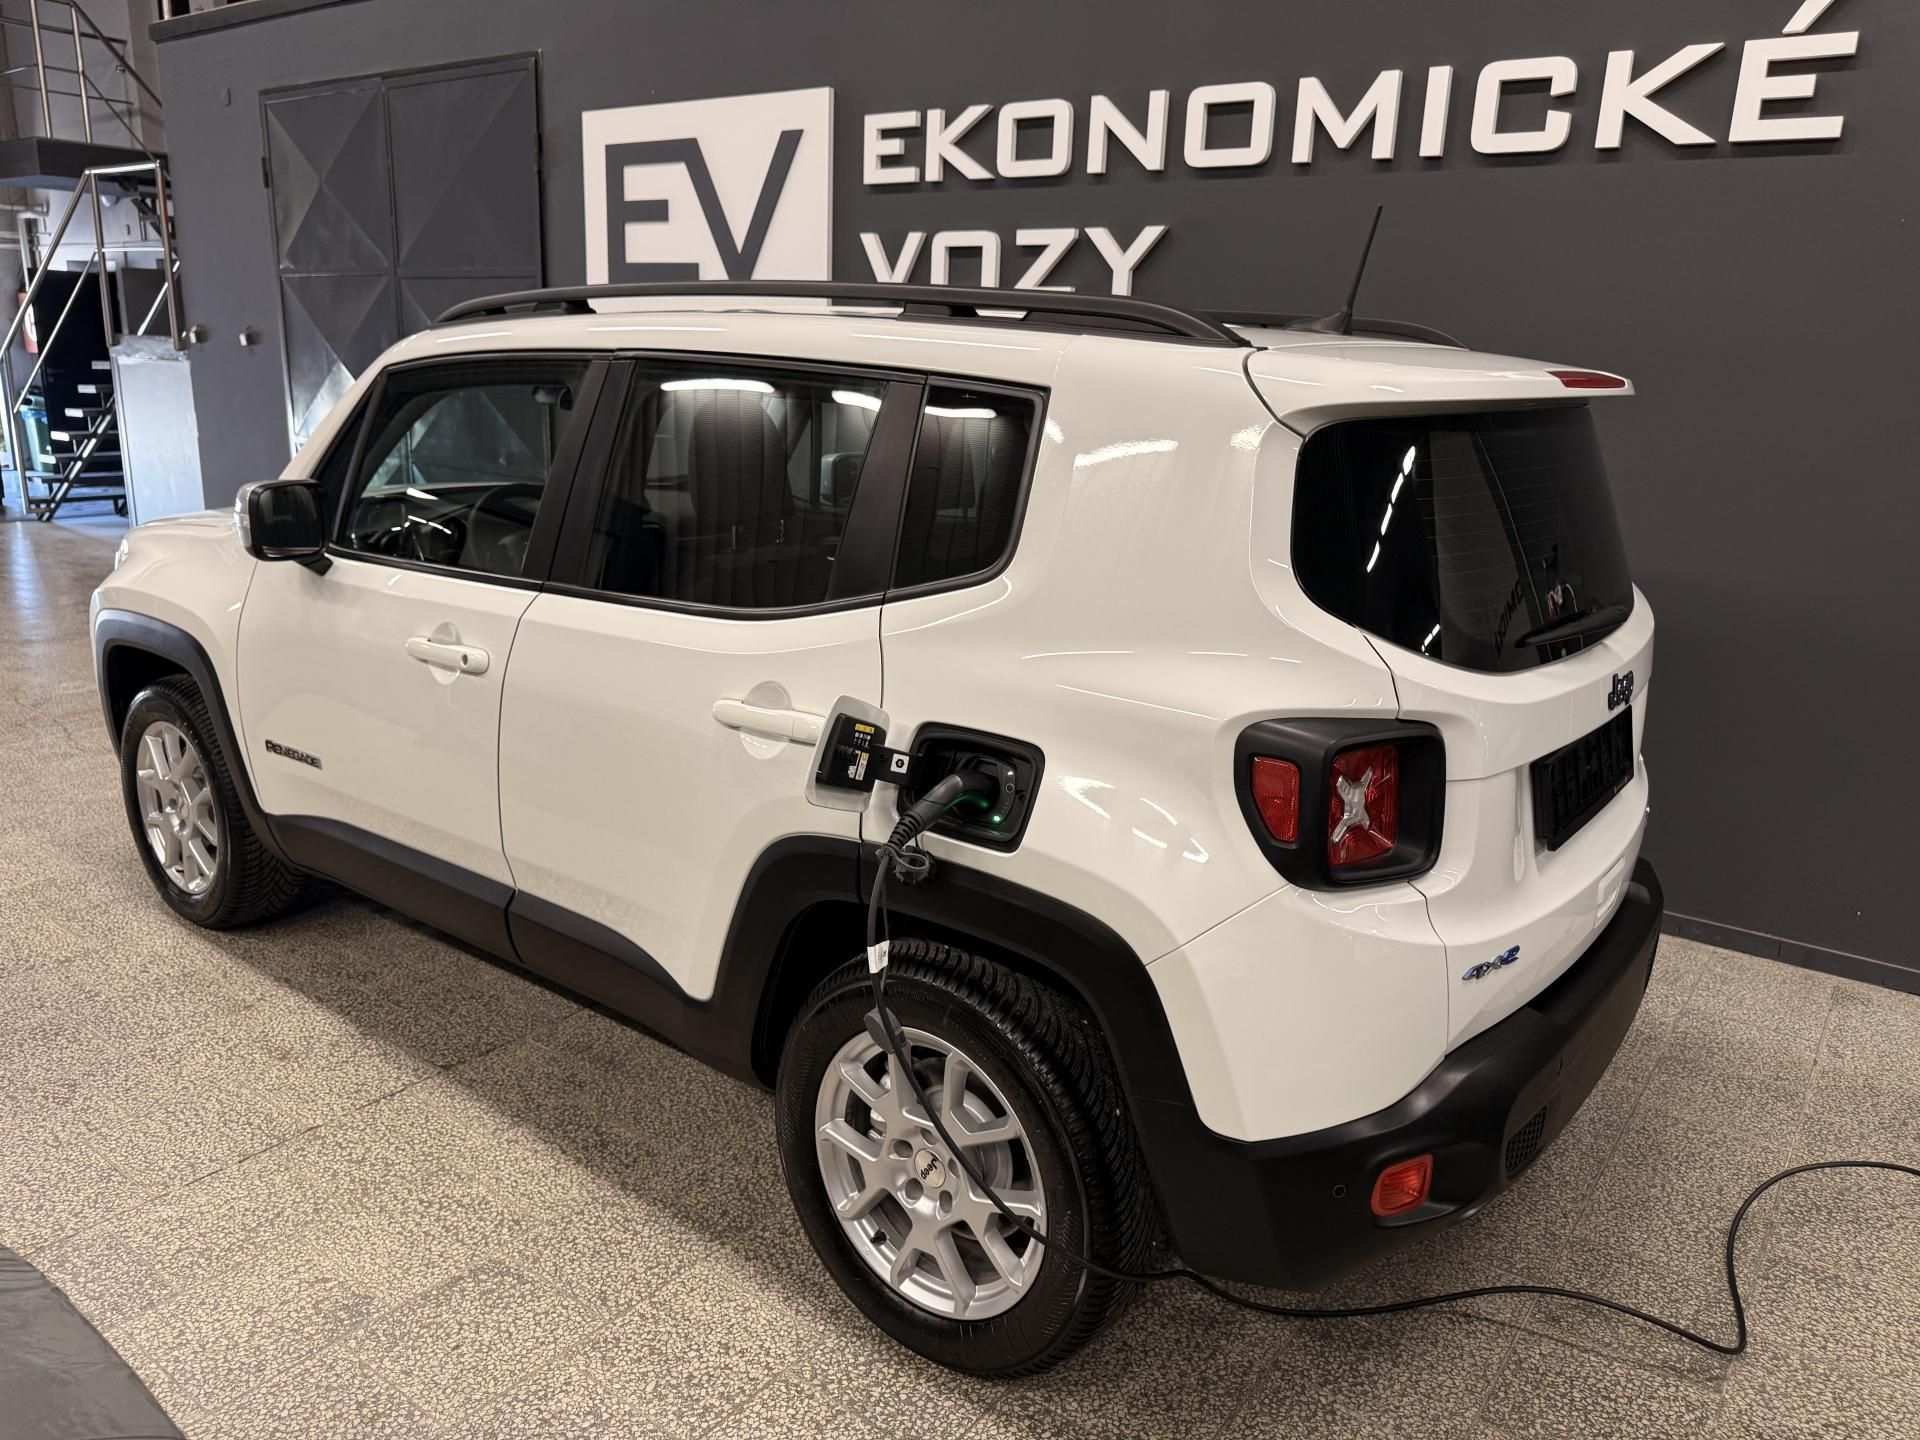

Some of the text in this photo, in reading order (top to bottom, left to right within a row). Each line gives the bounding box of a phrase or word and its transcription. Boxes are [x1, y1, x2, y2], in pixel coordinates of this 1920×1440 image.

[863, 0, 1860, 186] EKONOMICKÉ
[604, 128, 805, 285] EV
[859, 225, 1169, 297] VOZY
[265, 739, 323, 770] RENEGADE
[920, 1153, 939, 1180] Jeep
